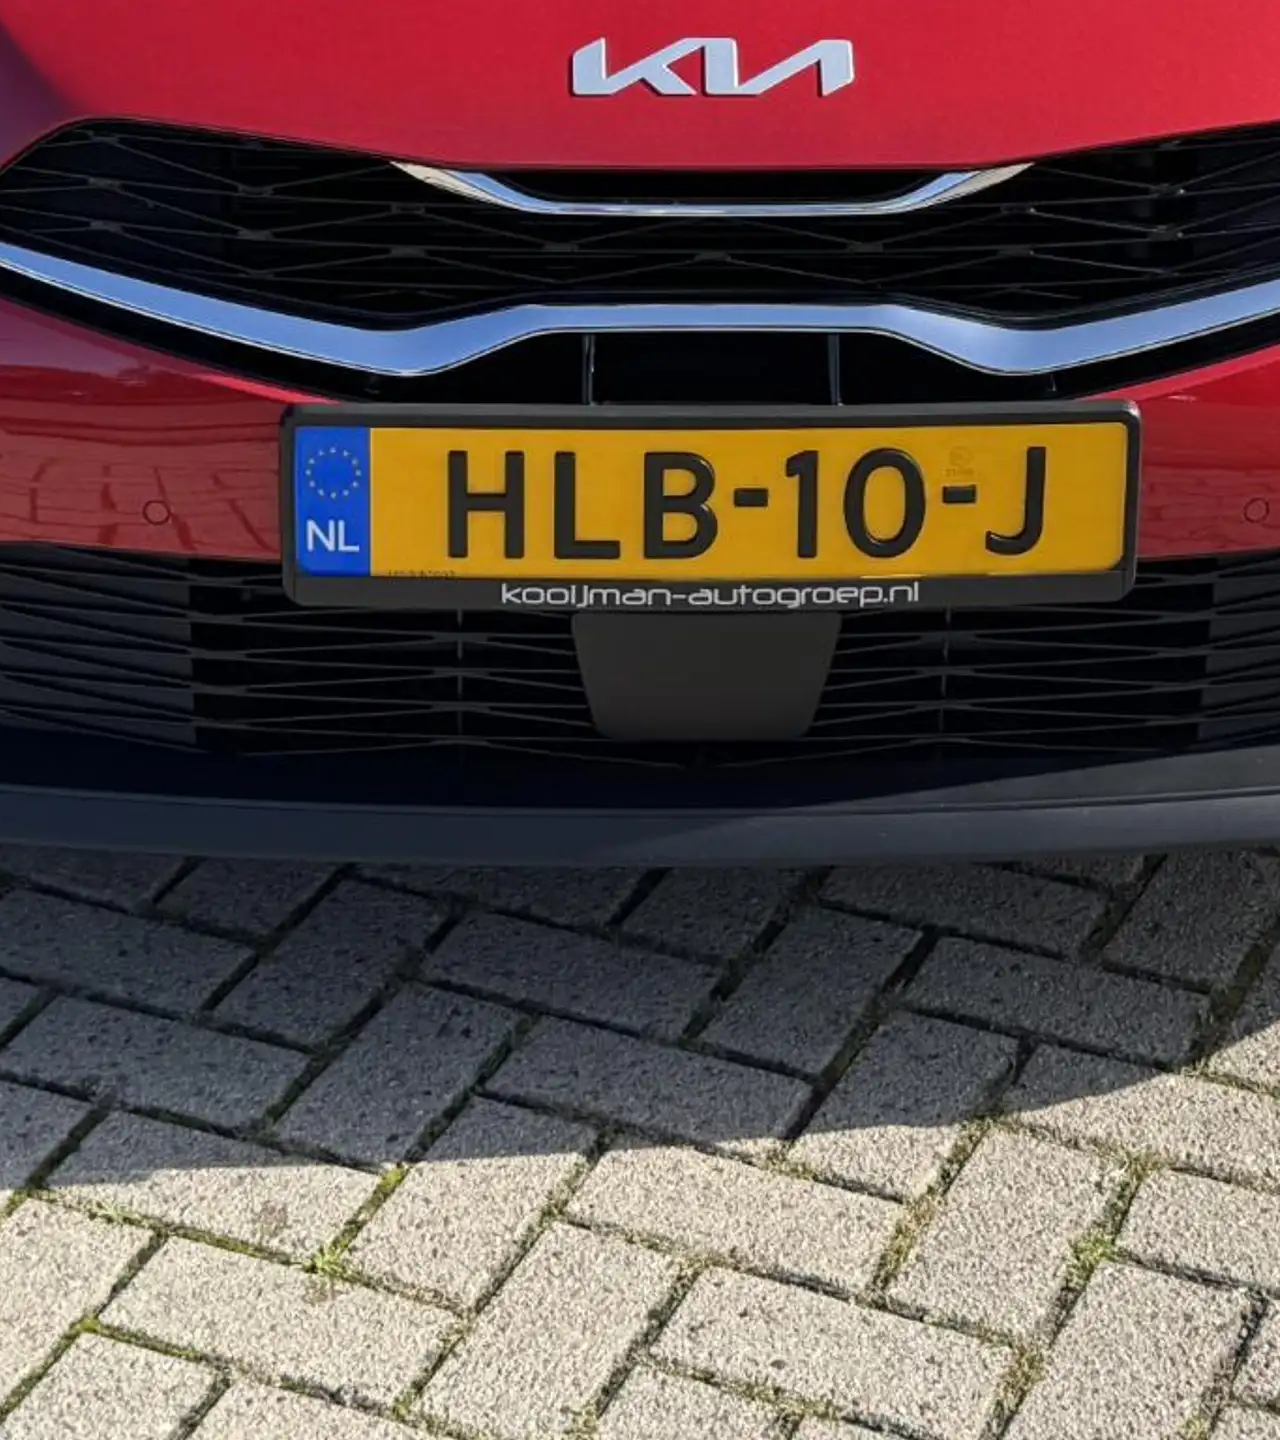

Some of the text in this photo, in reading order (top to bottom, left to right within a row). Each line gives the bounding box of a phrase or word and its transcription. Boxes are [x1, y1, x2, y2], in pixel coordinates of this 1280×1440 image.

[572, 37, 854, 97] KIA
[446, 446, 1048, 559] HLB-10-J
[306, 520, 360, 553] NL
